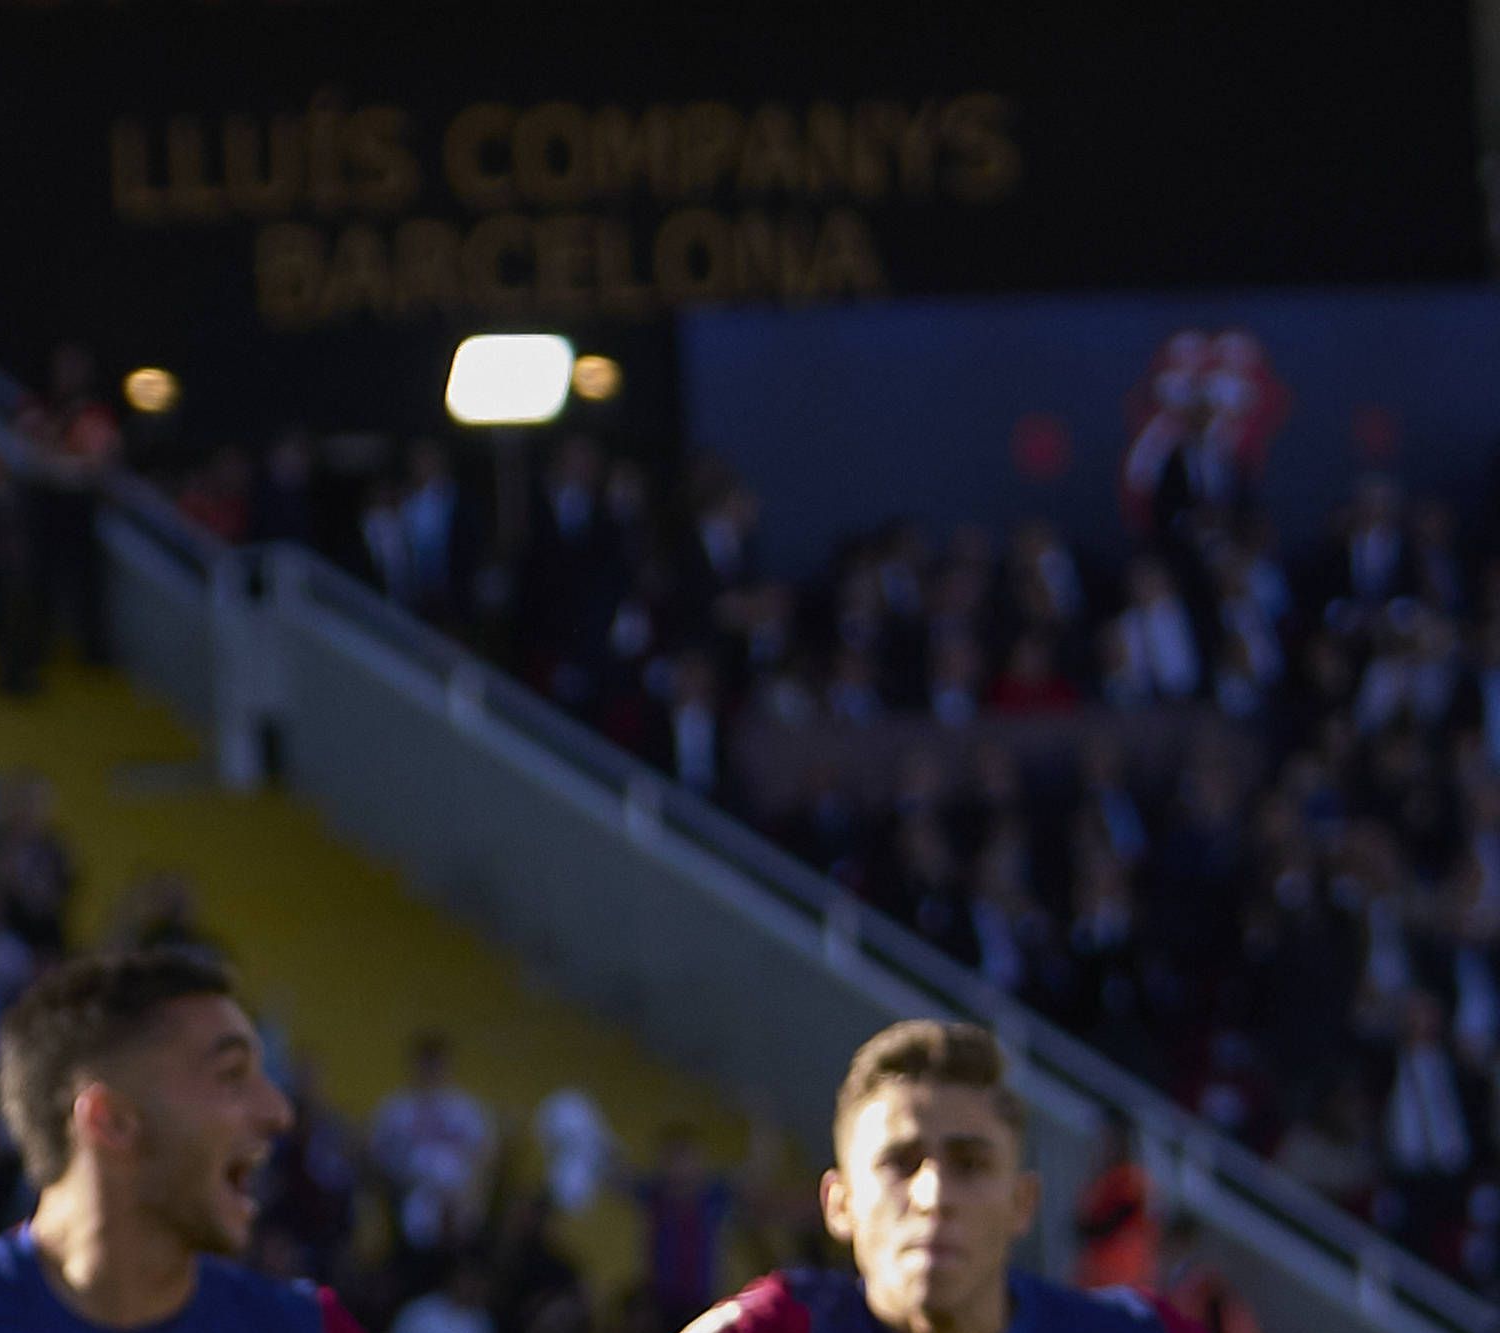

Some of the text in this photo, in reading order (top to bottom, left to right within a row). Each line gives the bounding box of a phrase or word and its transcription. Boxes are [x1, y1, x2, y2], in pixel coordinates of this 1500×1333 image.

[107, 82, 1023, 226] LLUÍS COMPANYS
[254, 208, 890, 332] BARCELONA
